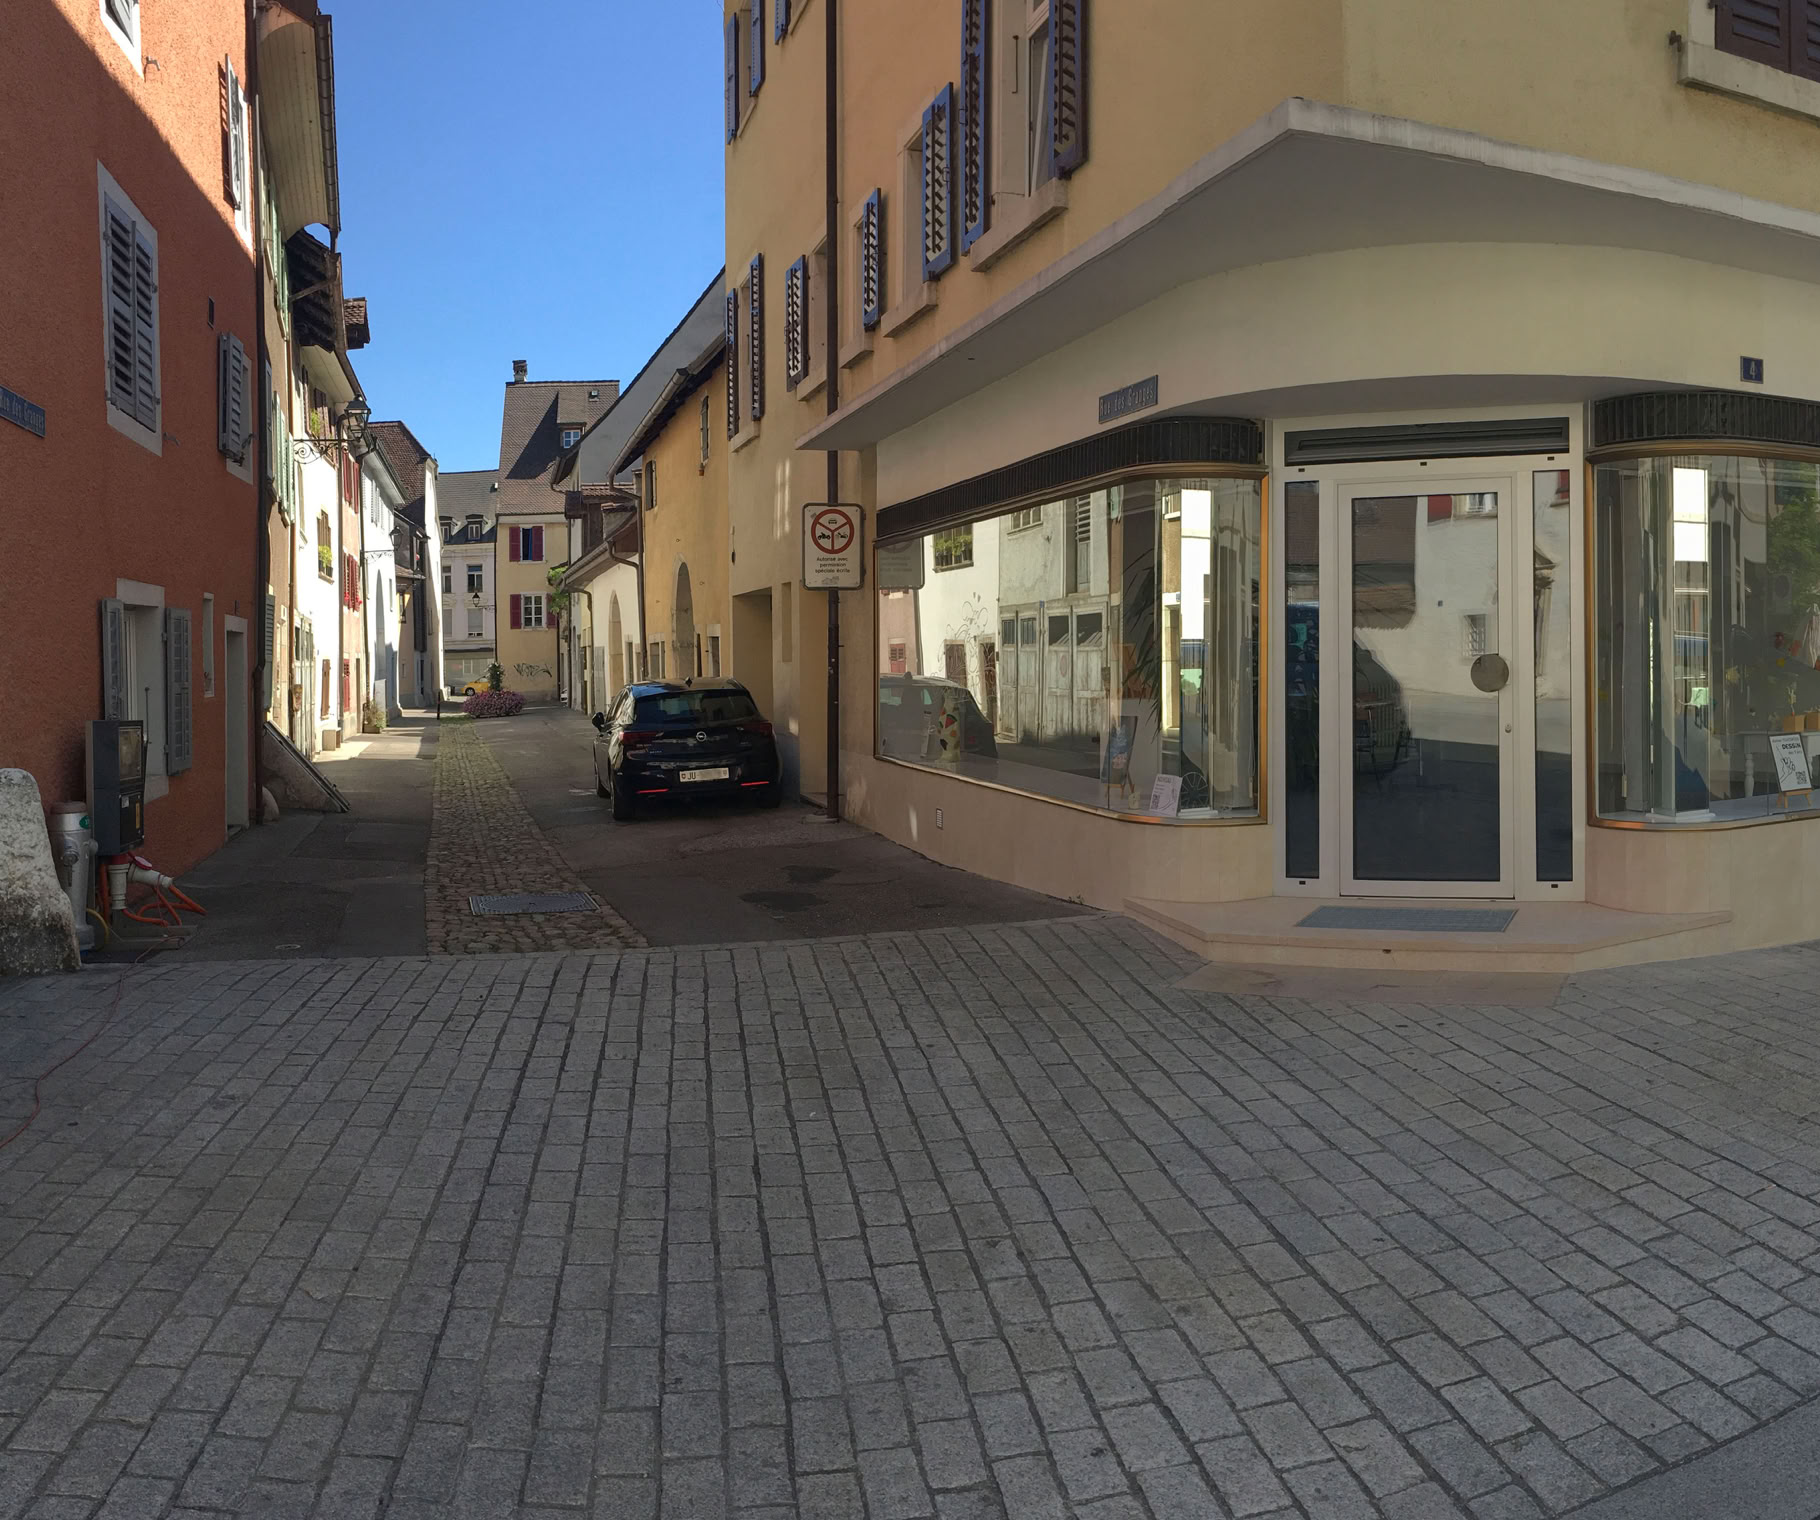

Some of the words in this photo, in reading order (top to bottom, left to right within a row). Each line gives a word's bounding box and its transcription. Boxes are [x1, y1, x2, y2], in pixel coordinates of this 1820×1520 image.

[1101, 399, 1111, 416] Rue
[1114, 393, 1125, 411] des
[1128, 386, 1154, 407] Granges
[687, 771, 696, 780] JU
